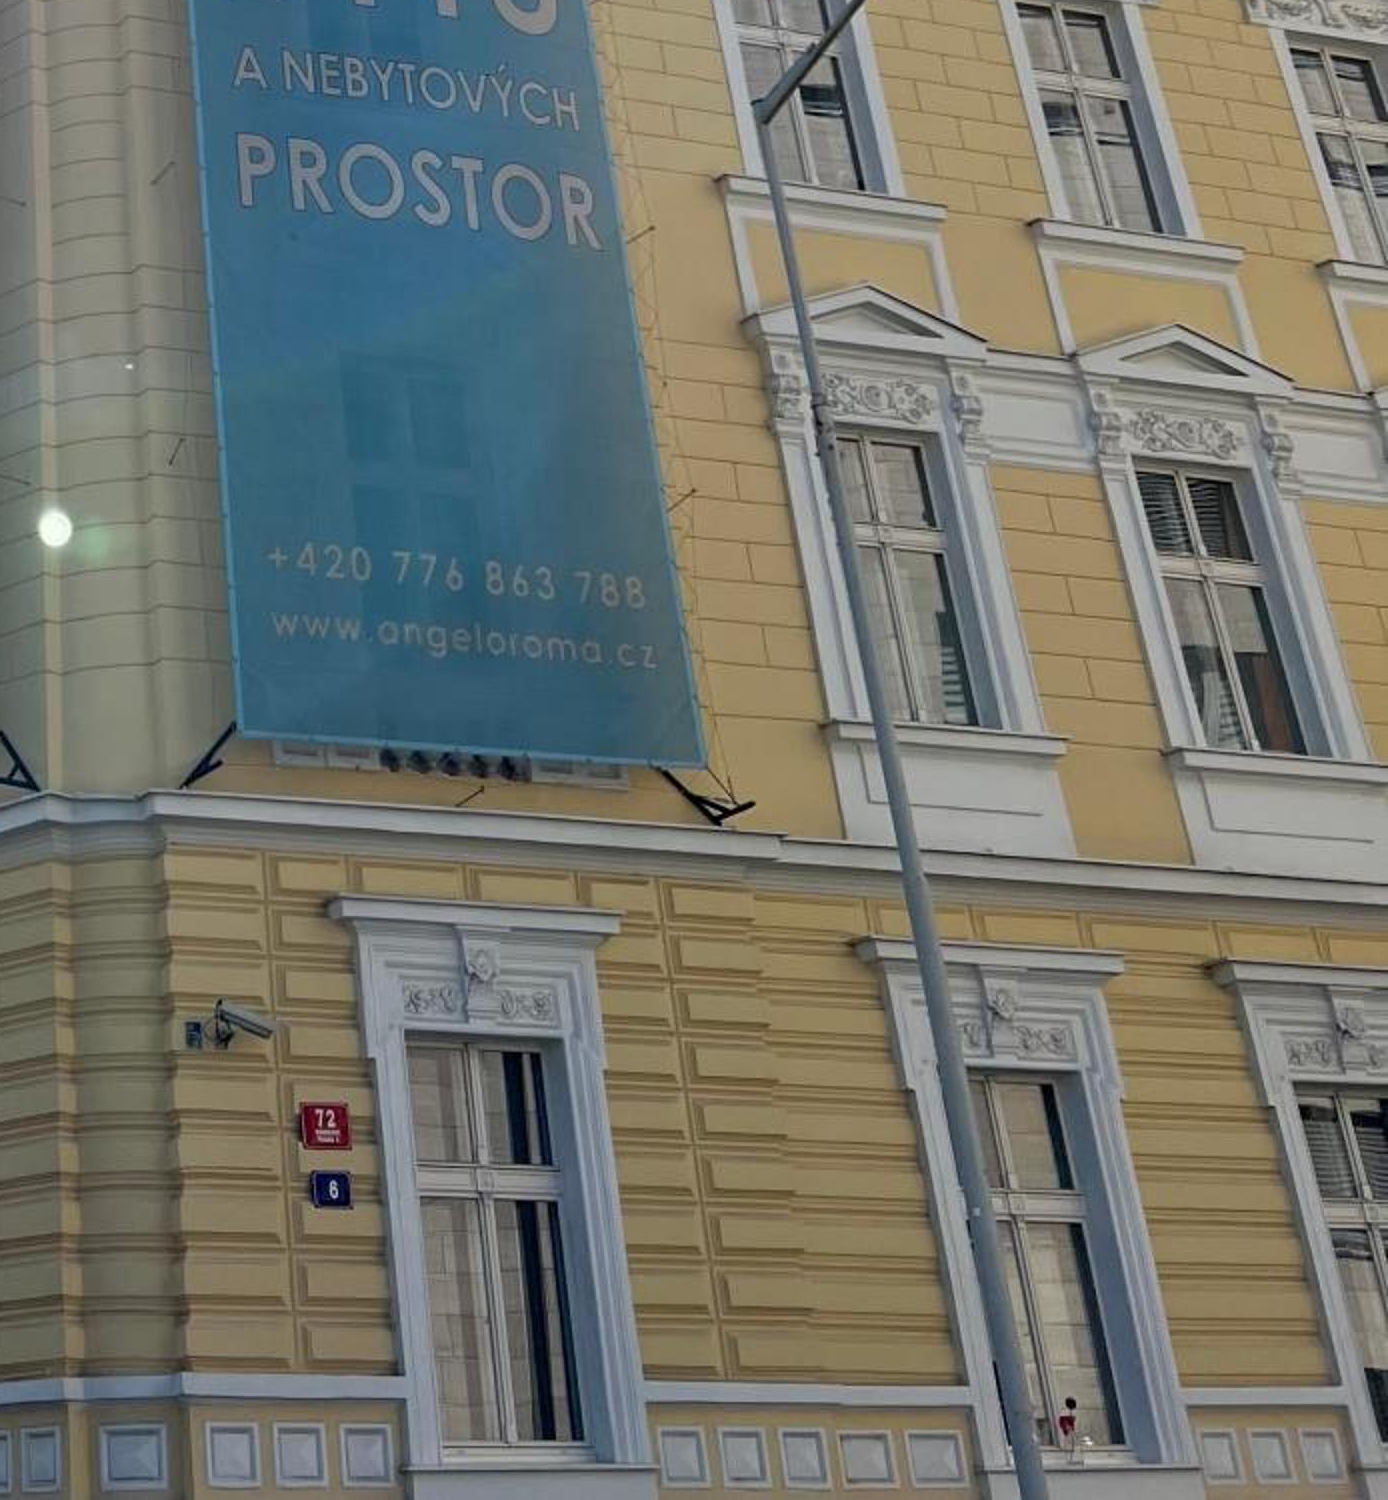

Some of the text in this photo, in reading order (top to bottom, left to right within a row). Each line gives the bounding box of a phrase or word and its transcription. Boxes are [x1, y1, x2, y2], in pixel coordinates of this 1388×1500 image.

[233, 46, 581, 132] A NEBYTOVÝCH
[235, 131, 602, 251] PROSTOR
[268, 543, 646, 609] +420 776 863 788
[272, 612, 658, 670] www.angeloroma.cz
[314, 1108, 337, 1128] 72
[329, 1179, 339, 1200] 6
